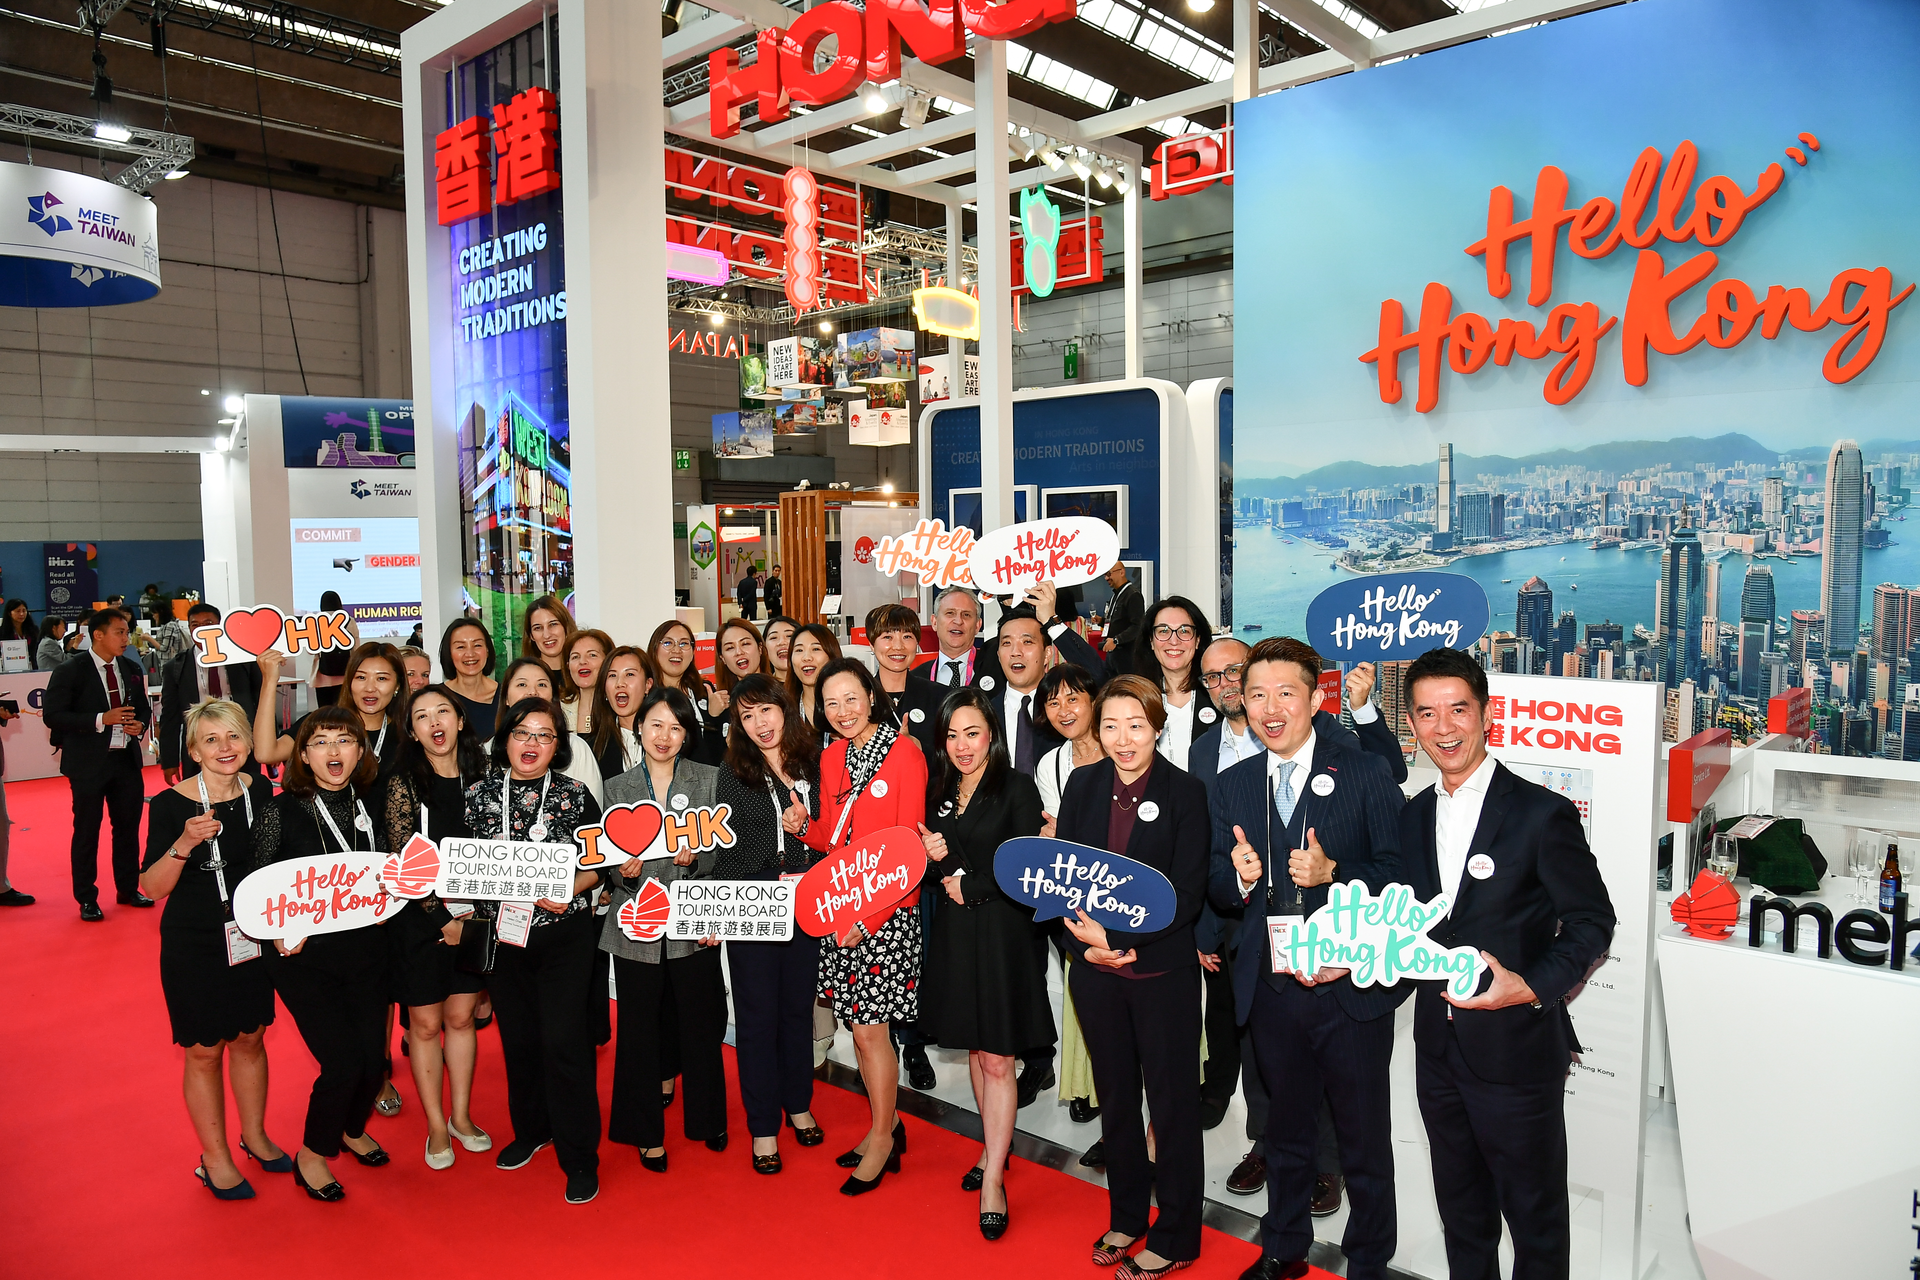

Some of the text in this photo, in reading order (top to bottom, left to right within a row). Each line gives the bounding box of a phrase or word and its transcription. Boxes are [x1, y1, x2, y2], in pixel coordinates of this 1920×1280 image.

[435, 86, 560, 227] 香港
[78, 207, 120, 227] MEET
[1463, 136, 1790, 308] Hello
[78, 220, 136, 247] TAIWAN
[459, 222, 547, 275] CREATING
[461, 263, 533, 310] MODERN
[461, 291, 567, 343] TRADITIONS
[1358, 249, 1917, 414] Hong Kong
[773, 343, 793, 357] NEW
[773, 355, 793, 365] IDEAS
[773, 363, 793, 373] START
[774, 370, 794, 381] HERE
[964, 360, 979, 371] EW
[965, 371, 979, 380] EAS
[964, 387, 979, 396] ERE
[965, 380, 979, 388] ART
[513, 410, 546, 469] WEST
[1045, 428, 1071, 439] HONG
[1072, 426, 1099, 437] KONG
[1064, 438, 1145, 457] TRADITIONS
[1069, 460, 1092, 473] Arts
[1109, 456, 1160, 473] neighbo
[302, 530, 352, 541] COMMIT
[1013, 527, 1078, 561] Hello
[370, 556, 416, 567] GENDER
[875, 539, 973, 586] Hong Ko
[992, 549, 1101, 586] Hong Kong
[354, 606, 398, 619] HUMAN
[1358, 583, 1440, 623] Hello
[196, 613, 352, 664] I HK
[1330, 610, 1464, 651] Hong Kong
[1317, 682, 1329, 690] rbour
[1511, 698, 1623, 727] HONG
[1511, 725, 1622, 755] KONG
[577, 807, 734, 866] I HK
[448, 842, 569, 864] HONG KONG
[448, 861, 568, 880] TOURISM BOARD
[829, 846, 884, 892] Hello
[1050, 852, 1131, 890] Hello
[290, 863, 367, 900] Hello
[445, 878, 567, 899] 香港旅遊發展局
[678, 885, 788, 901] HONG KONG
[814, 864, 910, 924] Hong Kong
[1017, 866, 1150, 928] Hong Kong
[260, 887, 391, 928] Hong Kong
[677, 904, 788, 918] TOURISM BOARD
[1325, 884, 1442, 941] Hello
[675, 920, 788, 936] 香港旅遊發展局
[1283, 921, 1483, 996] Hong Kong
[1603, 953, 1621, 962] Kong
[1589, 979, 1601, 987] Co.
[1602, 982, 1616, 990] Ltd.
[1578, 1063, 1596, 1073] Hong
[1597, 1067, 1615, 1077] Kong
